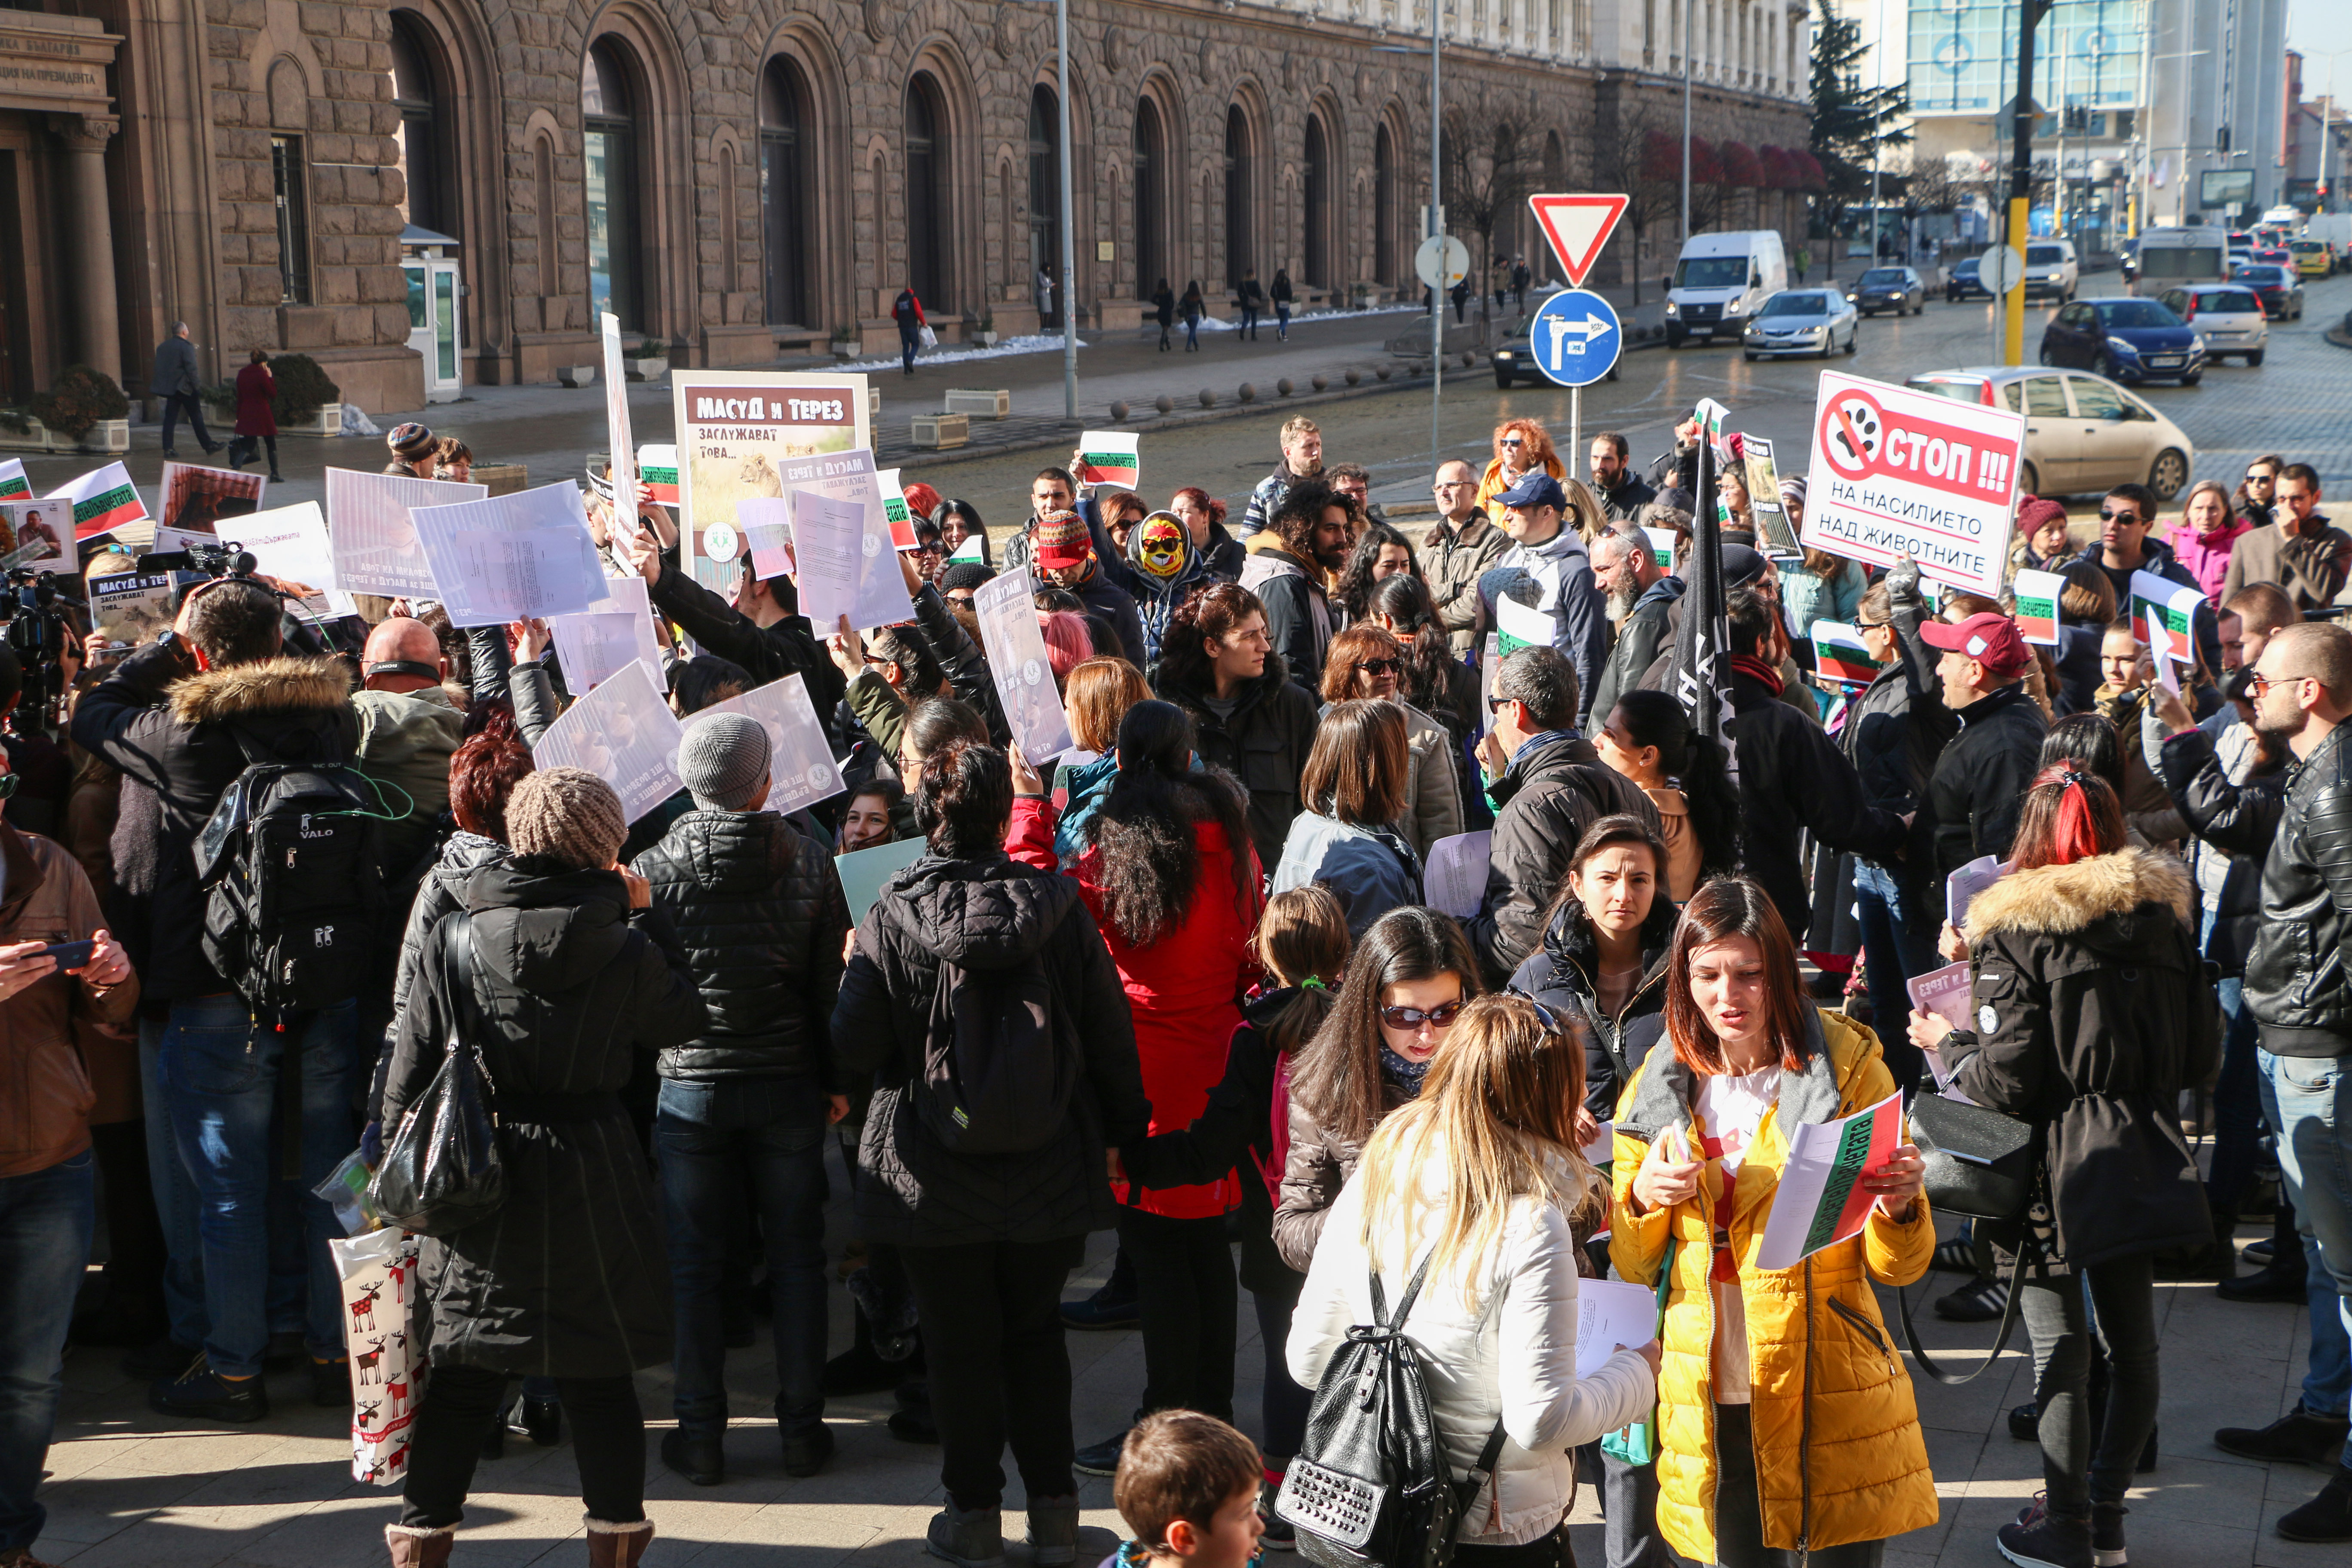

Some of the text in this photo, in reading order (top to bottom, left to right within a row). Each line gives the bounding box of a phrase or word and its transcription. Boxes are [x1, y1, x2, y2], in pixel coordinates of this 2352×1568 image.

[27, 40, 80, 55] БЪЛГАРИЯ
[22, 69, 35, 79] НА
[37, 70, 95, 86] ПРЕЗИДЕНТА
[697, 397, 765, 420] МАСУД
[788, 398, 844, 421] ТЕРЕЗ
[699, 429, 777, 441] ЗАСЛУЖАВАТ
[1886, 428, 2009, 493] СТОП !!!
[1832, 482, 1981, 535] НА НАСИЛИЕТО
[1820, 514, 1985, 573] НАД ЖИВОТНИТЕ
[99, 578, 137, 593] МАСУД
[150, 575, 167, 586] ТЕР
[101, 591, 145, 603] ЗАСЛУЖАВАТ
[300, 830, 333, 839] VALO
